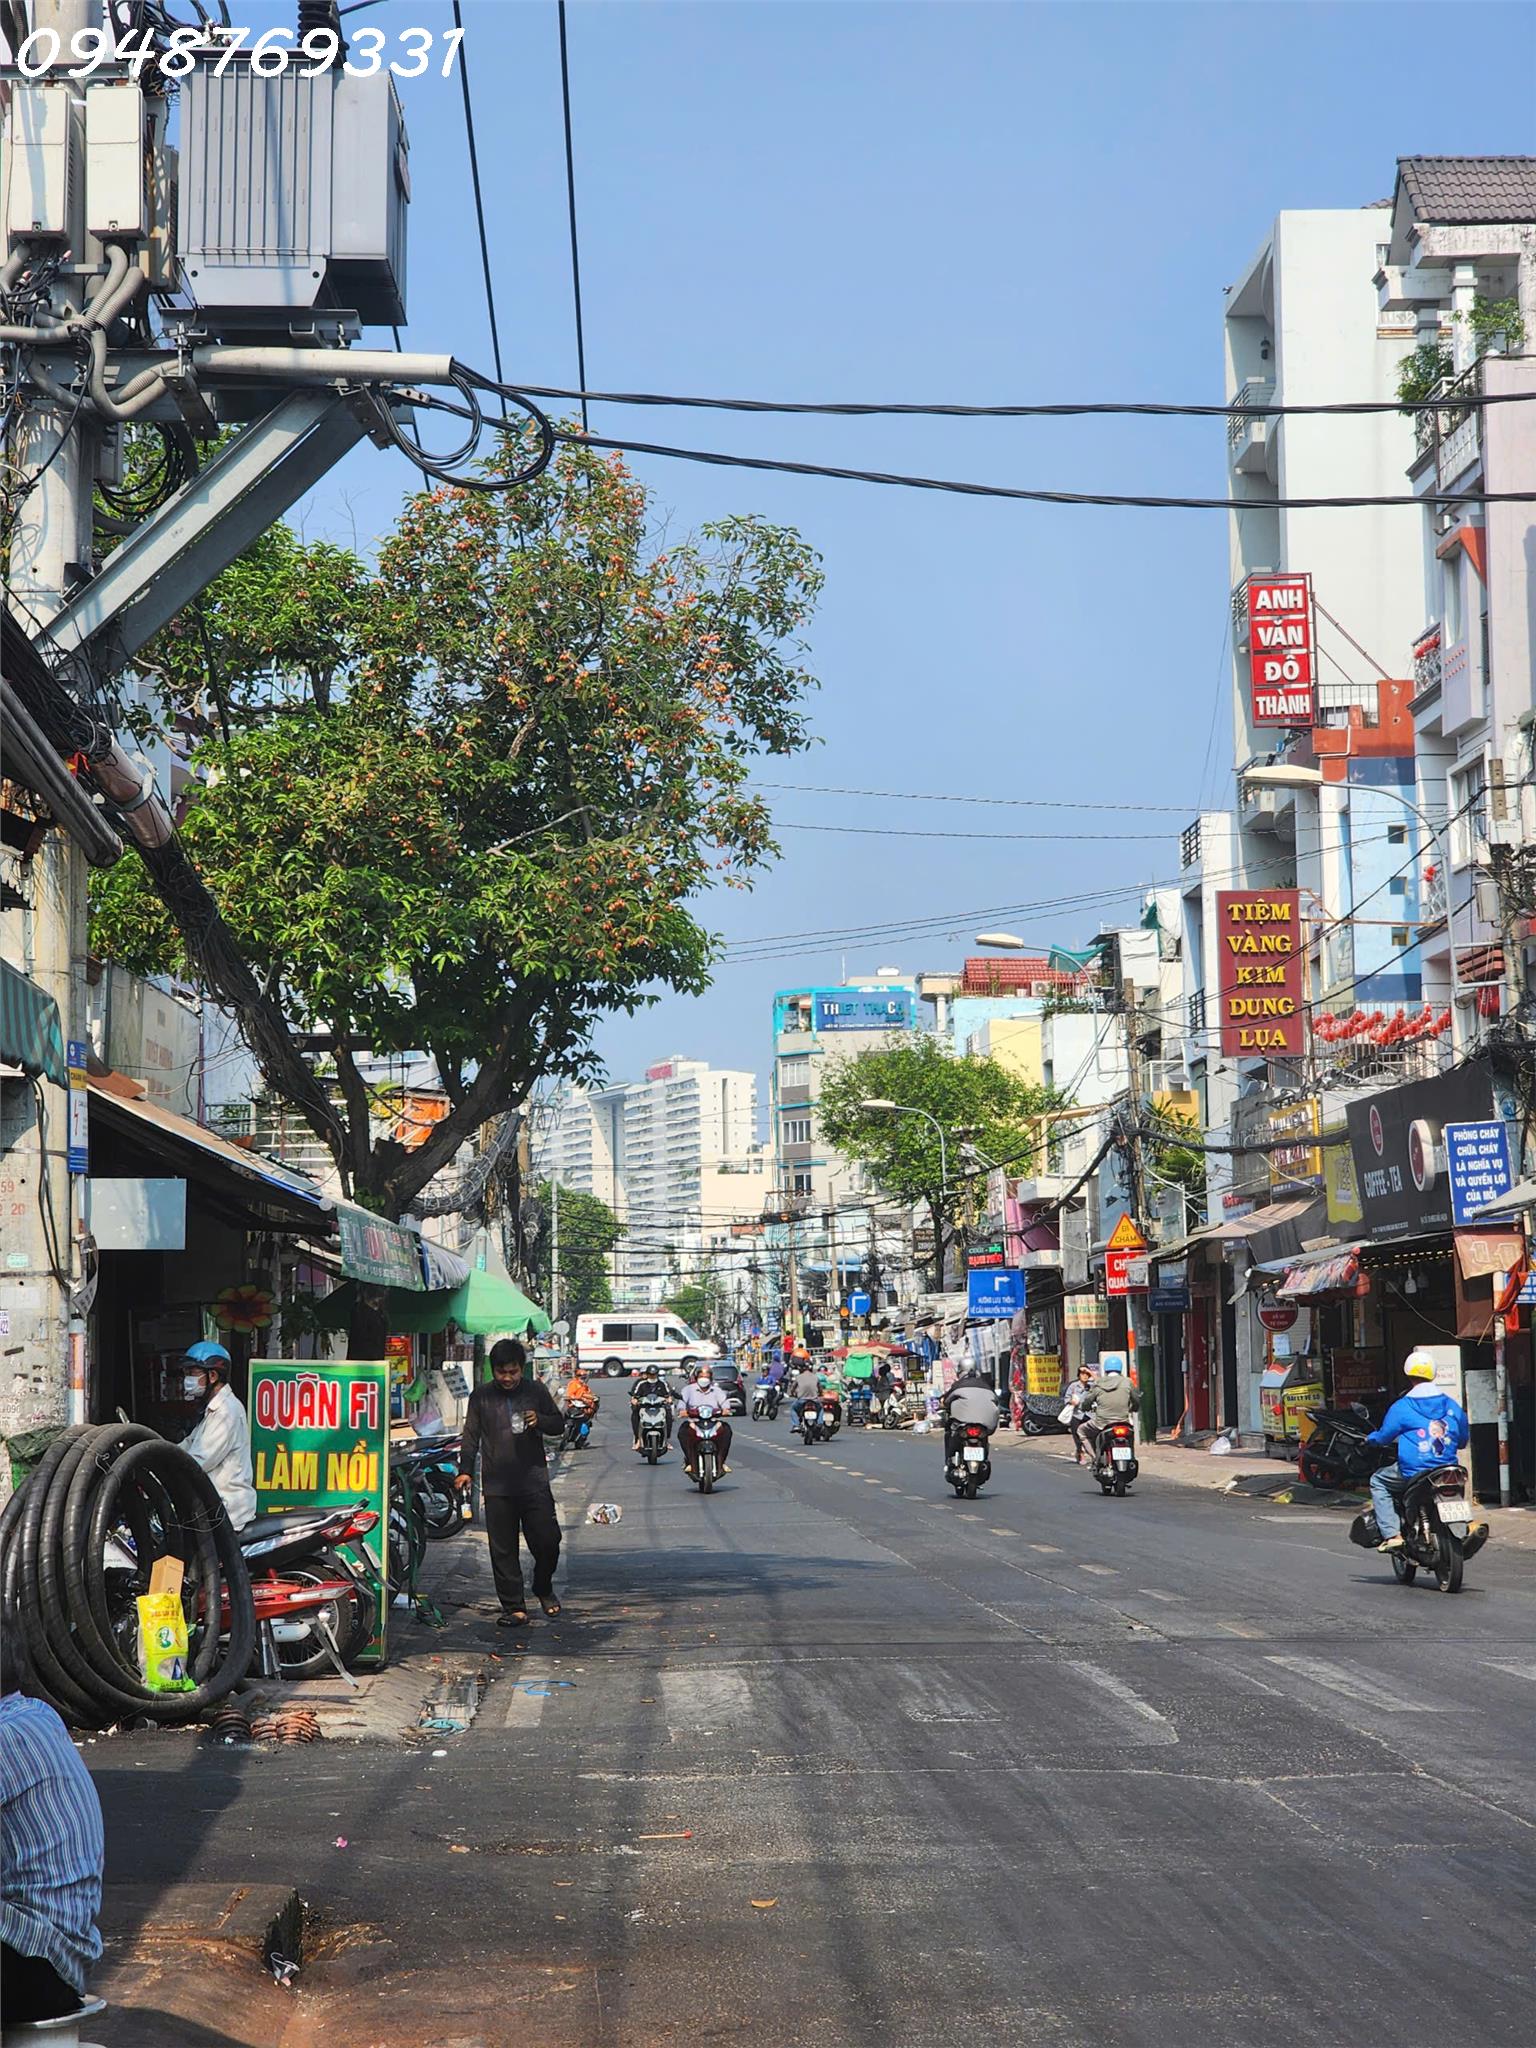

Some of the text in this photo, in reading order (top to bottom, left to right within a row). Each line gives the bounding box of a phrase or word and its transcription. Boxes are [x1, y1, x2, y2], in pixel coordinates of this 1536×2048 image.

[1255, 589, 1304, 610] ANH
[1257, 619, 1304, 647] VĂN
[1264, 655, 1300, 681] ĐÔ
[1256, 689, 1310, 716] THÀNH
[1227, 898, 1291, 925] TIỆM
[1227, 929, 1292, 954] VÀNG
[1236, 966, 1286, 984] KIM
[1229, 997, 1295, 1017] DUNG
[1239, 1029, 1287, 1051] LỤA
[1453, 1126, 1499, 1141] PHÒNG CHÁY
[1457, 1142, 1499, 1156] CHỮA CHÁY
[1456, 1158, 1503, 1172] LÀ NGHĨA VỤ
[1364, 1169, 1387, 1198] COFFEE
[1389, 1165, 1403, 1193] TEA
[1455, 1175, 1466, 1187] VÀ
[1466, 1189, 1481, 1202] CỦA
[256, 1371, 341, 1432] QUÂN
[255, 1442, 319, 1491] LÀM
